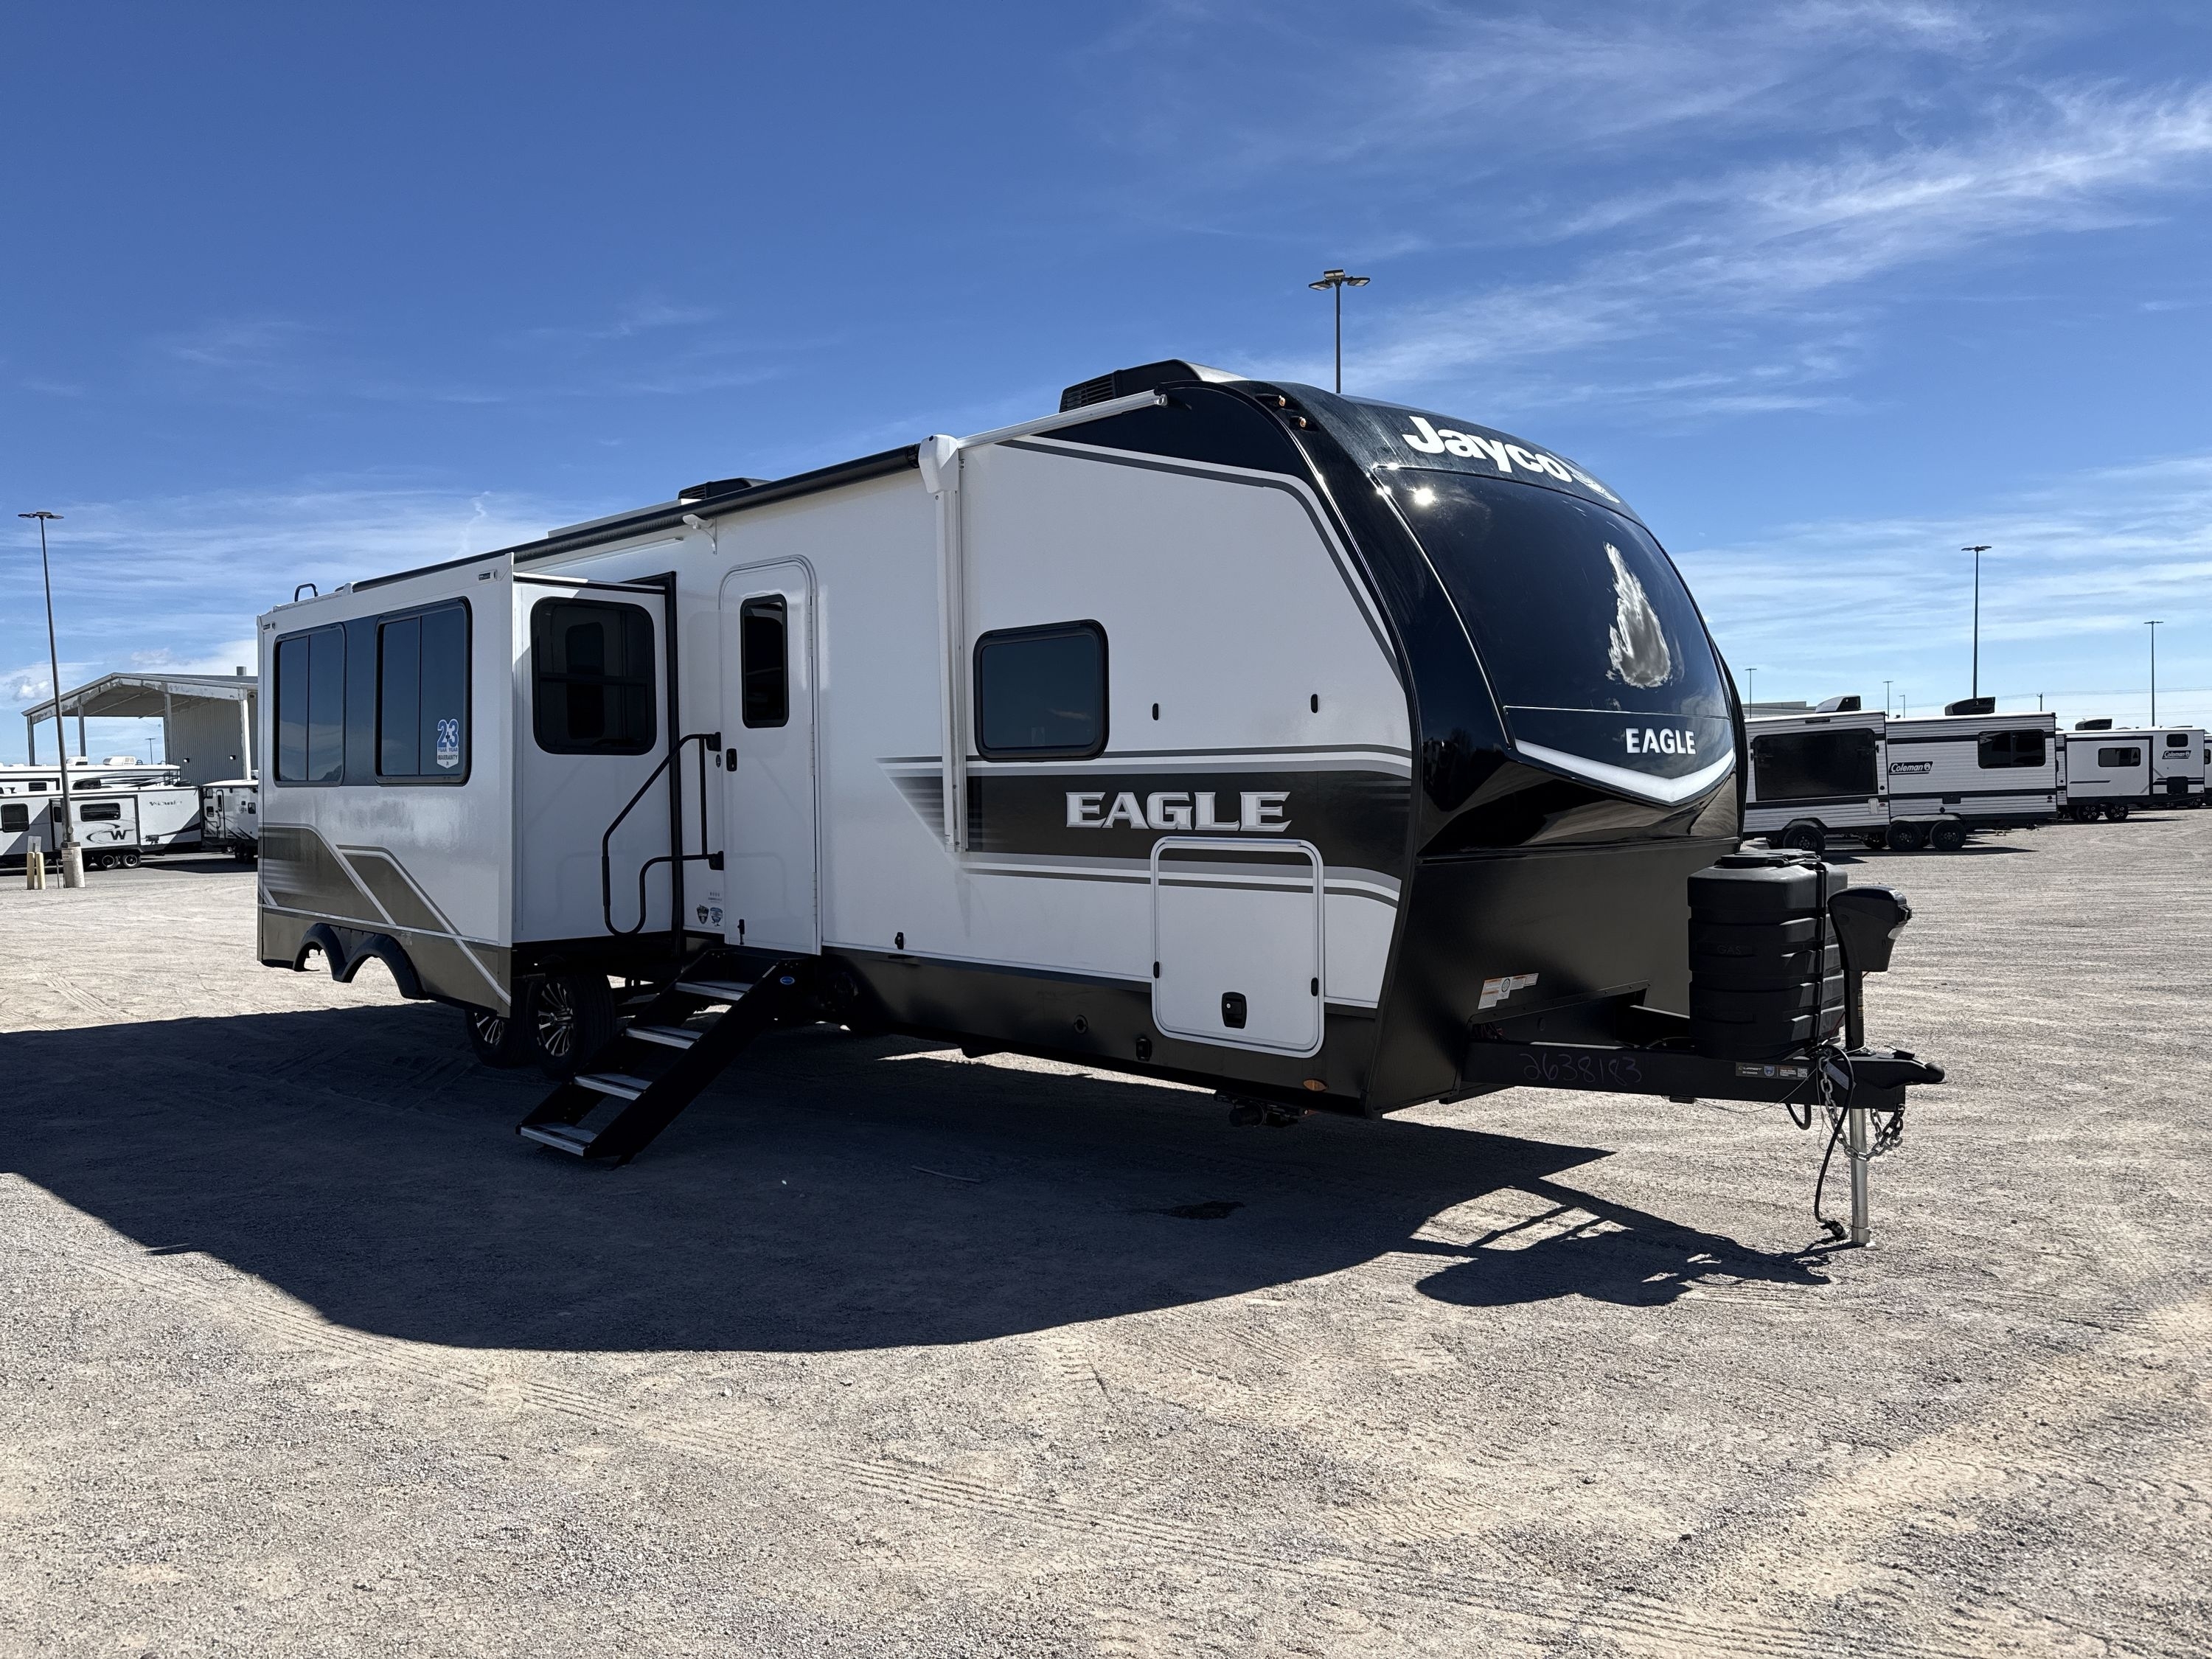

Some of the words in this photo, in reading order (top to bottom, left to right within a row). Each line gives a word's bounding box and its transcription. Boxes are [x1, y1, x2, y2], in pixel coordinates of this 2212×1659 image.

[1402, 416, 1572, 482] Jayco
[1625, 728, 1697, 754] EAGLE
[1891, 762, 1924, 772] Coleman
[1065, 792, 1292, 832] EAGLE
[1717, 945, 1741, 956] GAS
[1519, 1053, 1642, 1086] 2638183
